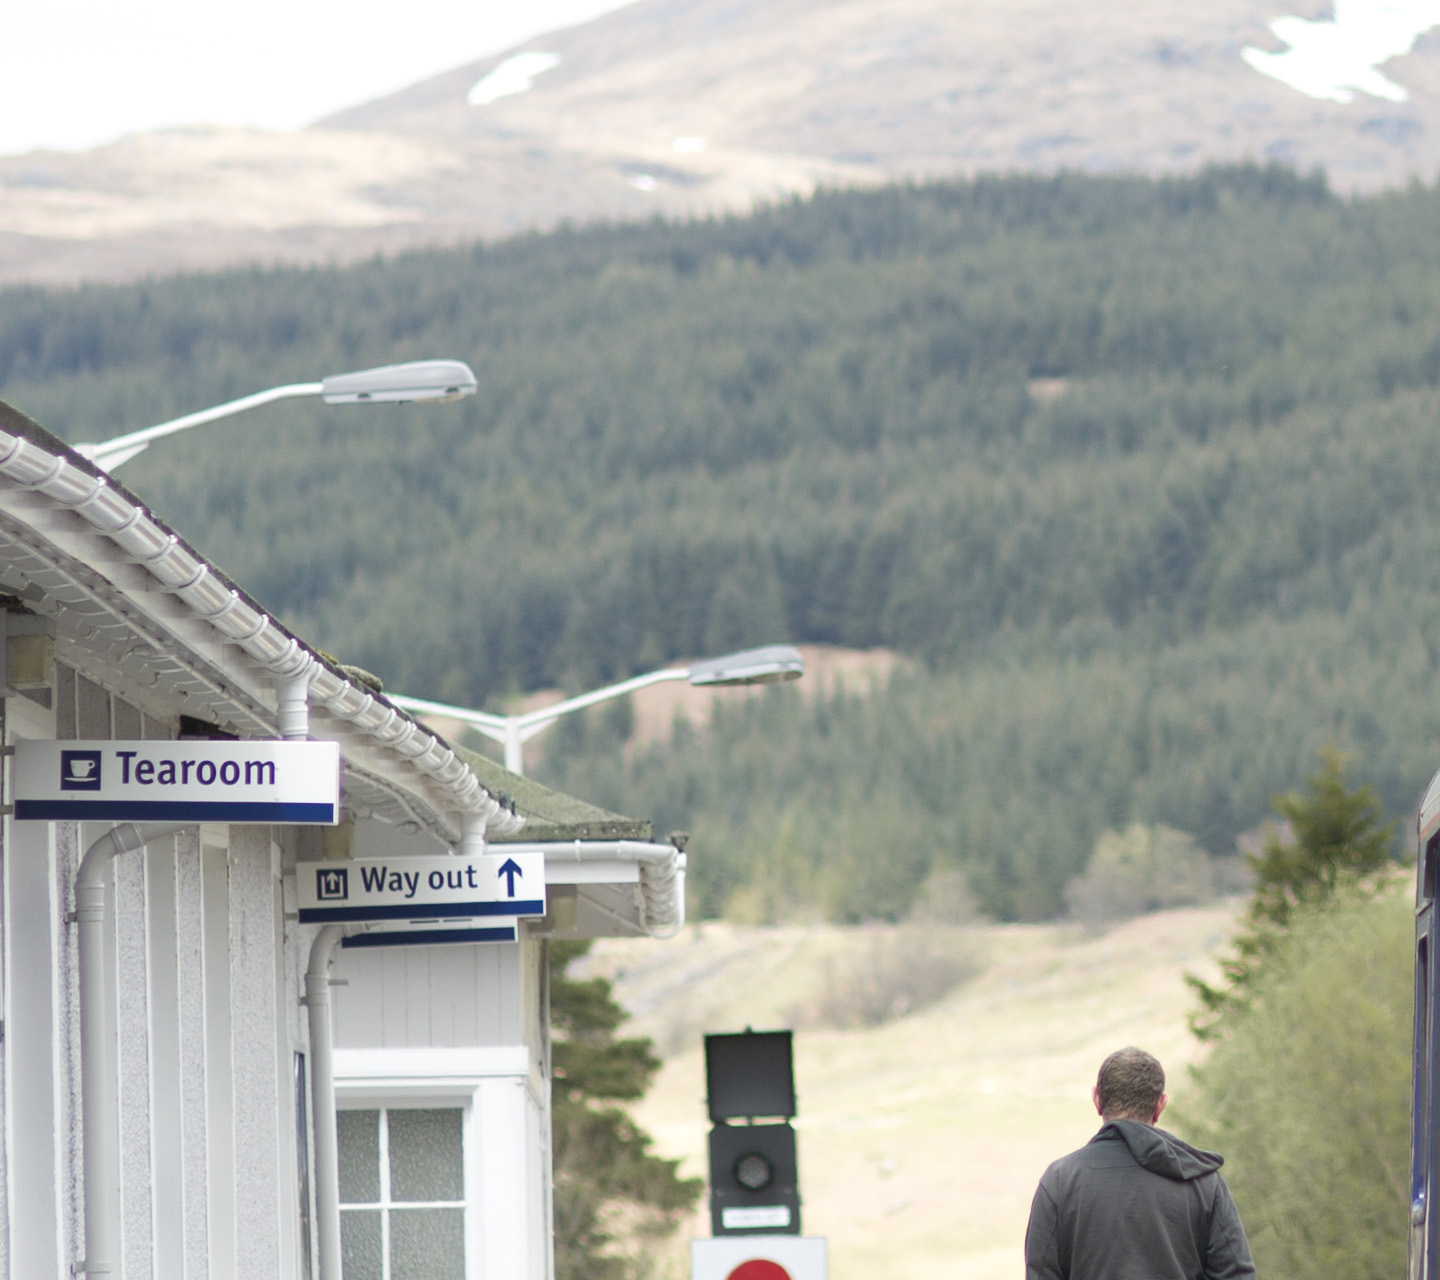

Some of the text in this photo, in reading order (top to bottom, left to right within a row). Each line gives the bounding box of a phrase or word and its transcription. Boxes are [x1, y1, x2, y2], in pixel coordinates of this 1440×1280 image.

[116, 751, 276, 786] Tearoom
[361, 865, 479, 899] Way out
